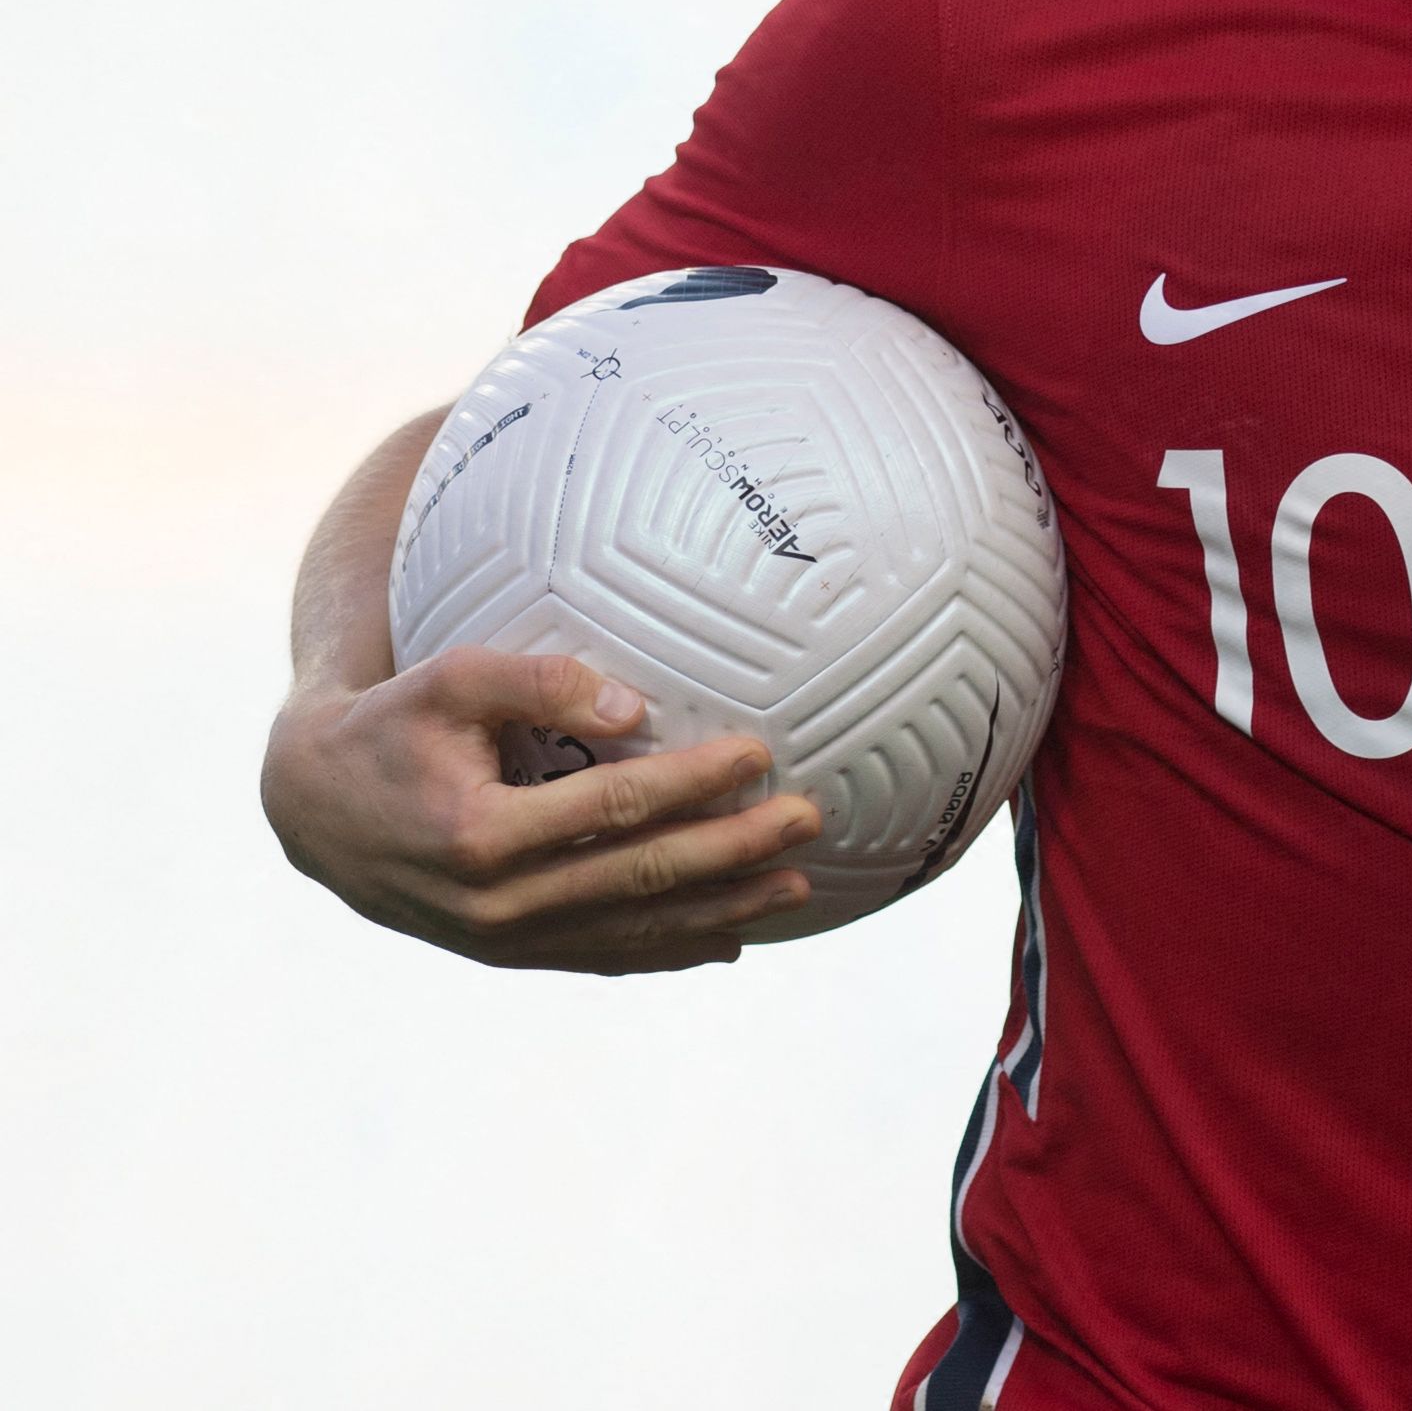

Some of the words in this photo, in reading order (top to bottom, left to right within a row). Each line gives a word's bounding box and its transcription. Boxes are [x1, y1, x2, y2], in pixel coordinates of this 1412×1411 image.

[656, 408, 818, 563] AEROWSCULPT
[678, 403, 799, 529] TECHNOLOGY
[748, 519, 777, 550] NIKE
